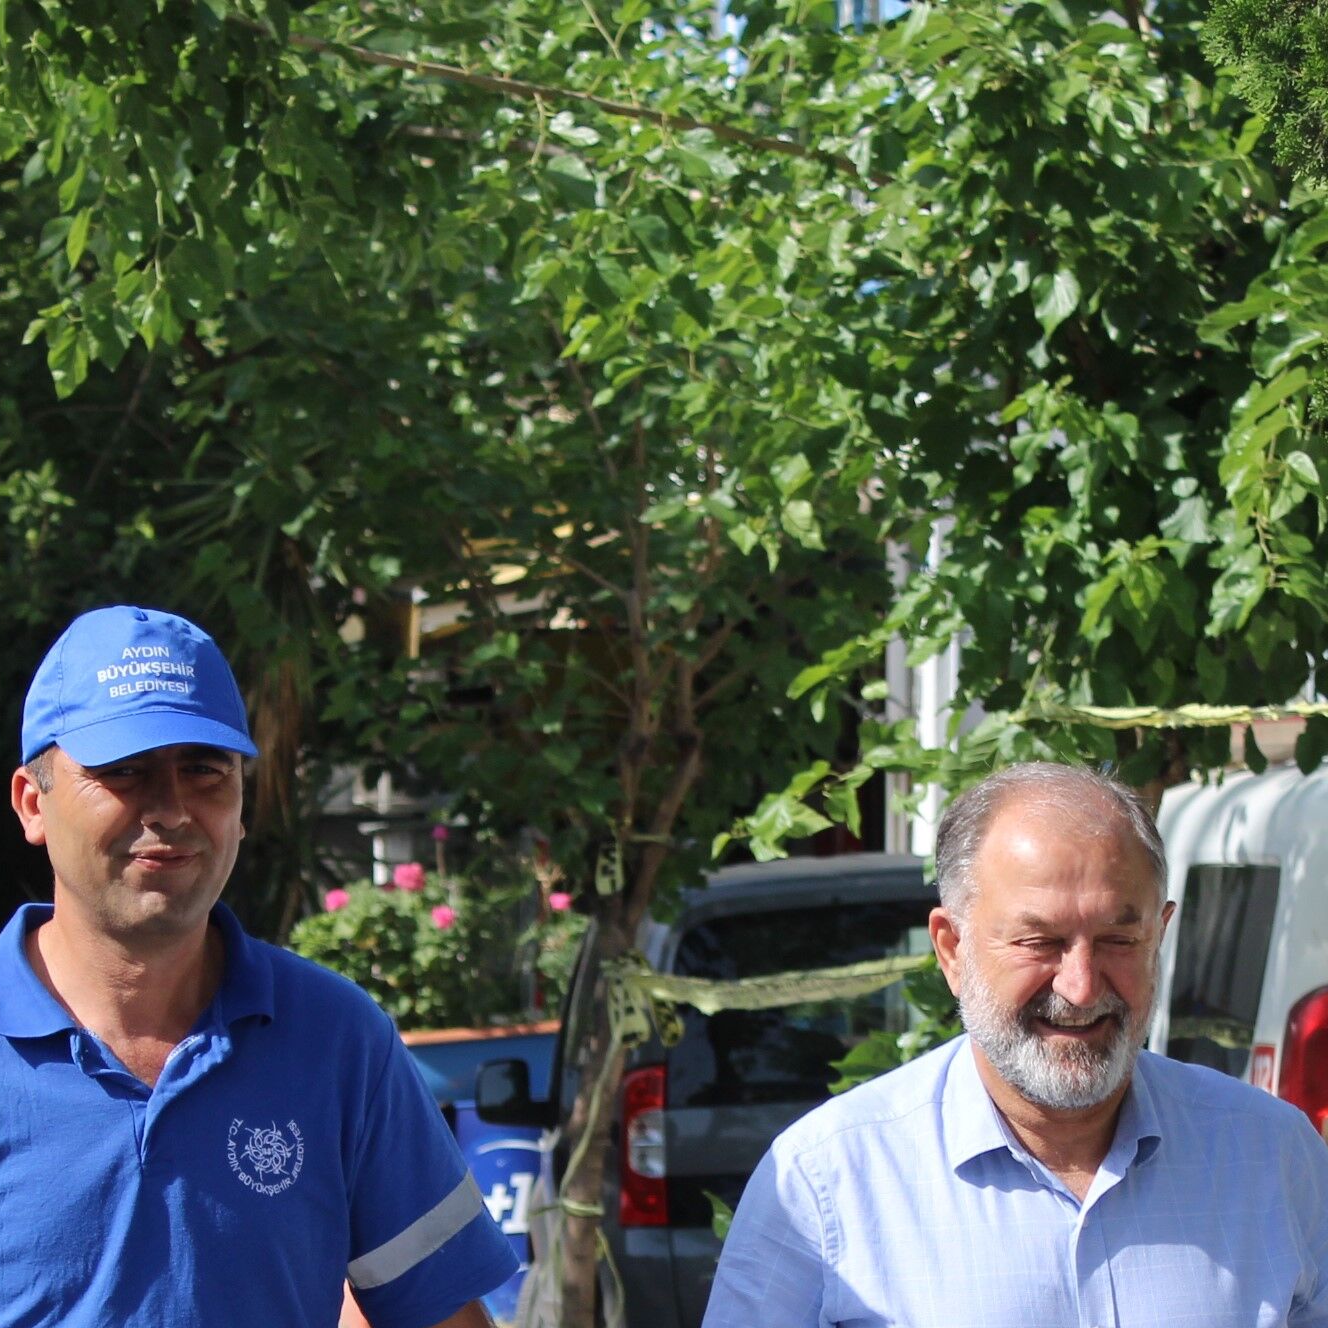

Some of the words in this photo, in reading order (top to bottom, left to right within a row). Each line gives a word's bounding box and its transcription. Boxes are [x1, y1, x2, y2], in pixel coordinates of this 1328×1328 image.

[121, 646, 170, 660] AYDIN
[97, 661, 196, 683] BÜYÜKŞEHİR
[109, 679, 189, 698] BELEDİYESİ
